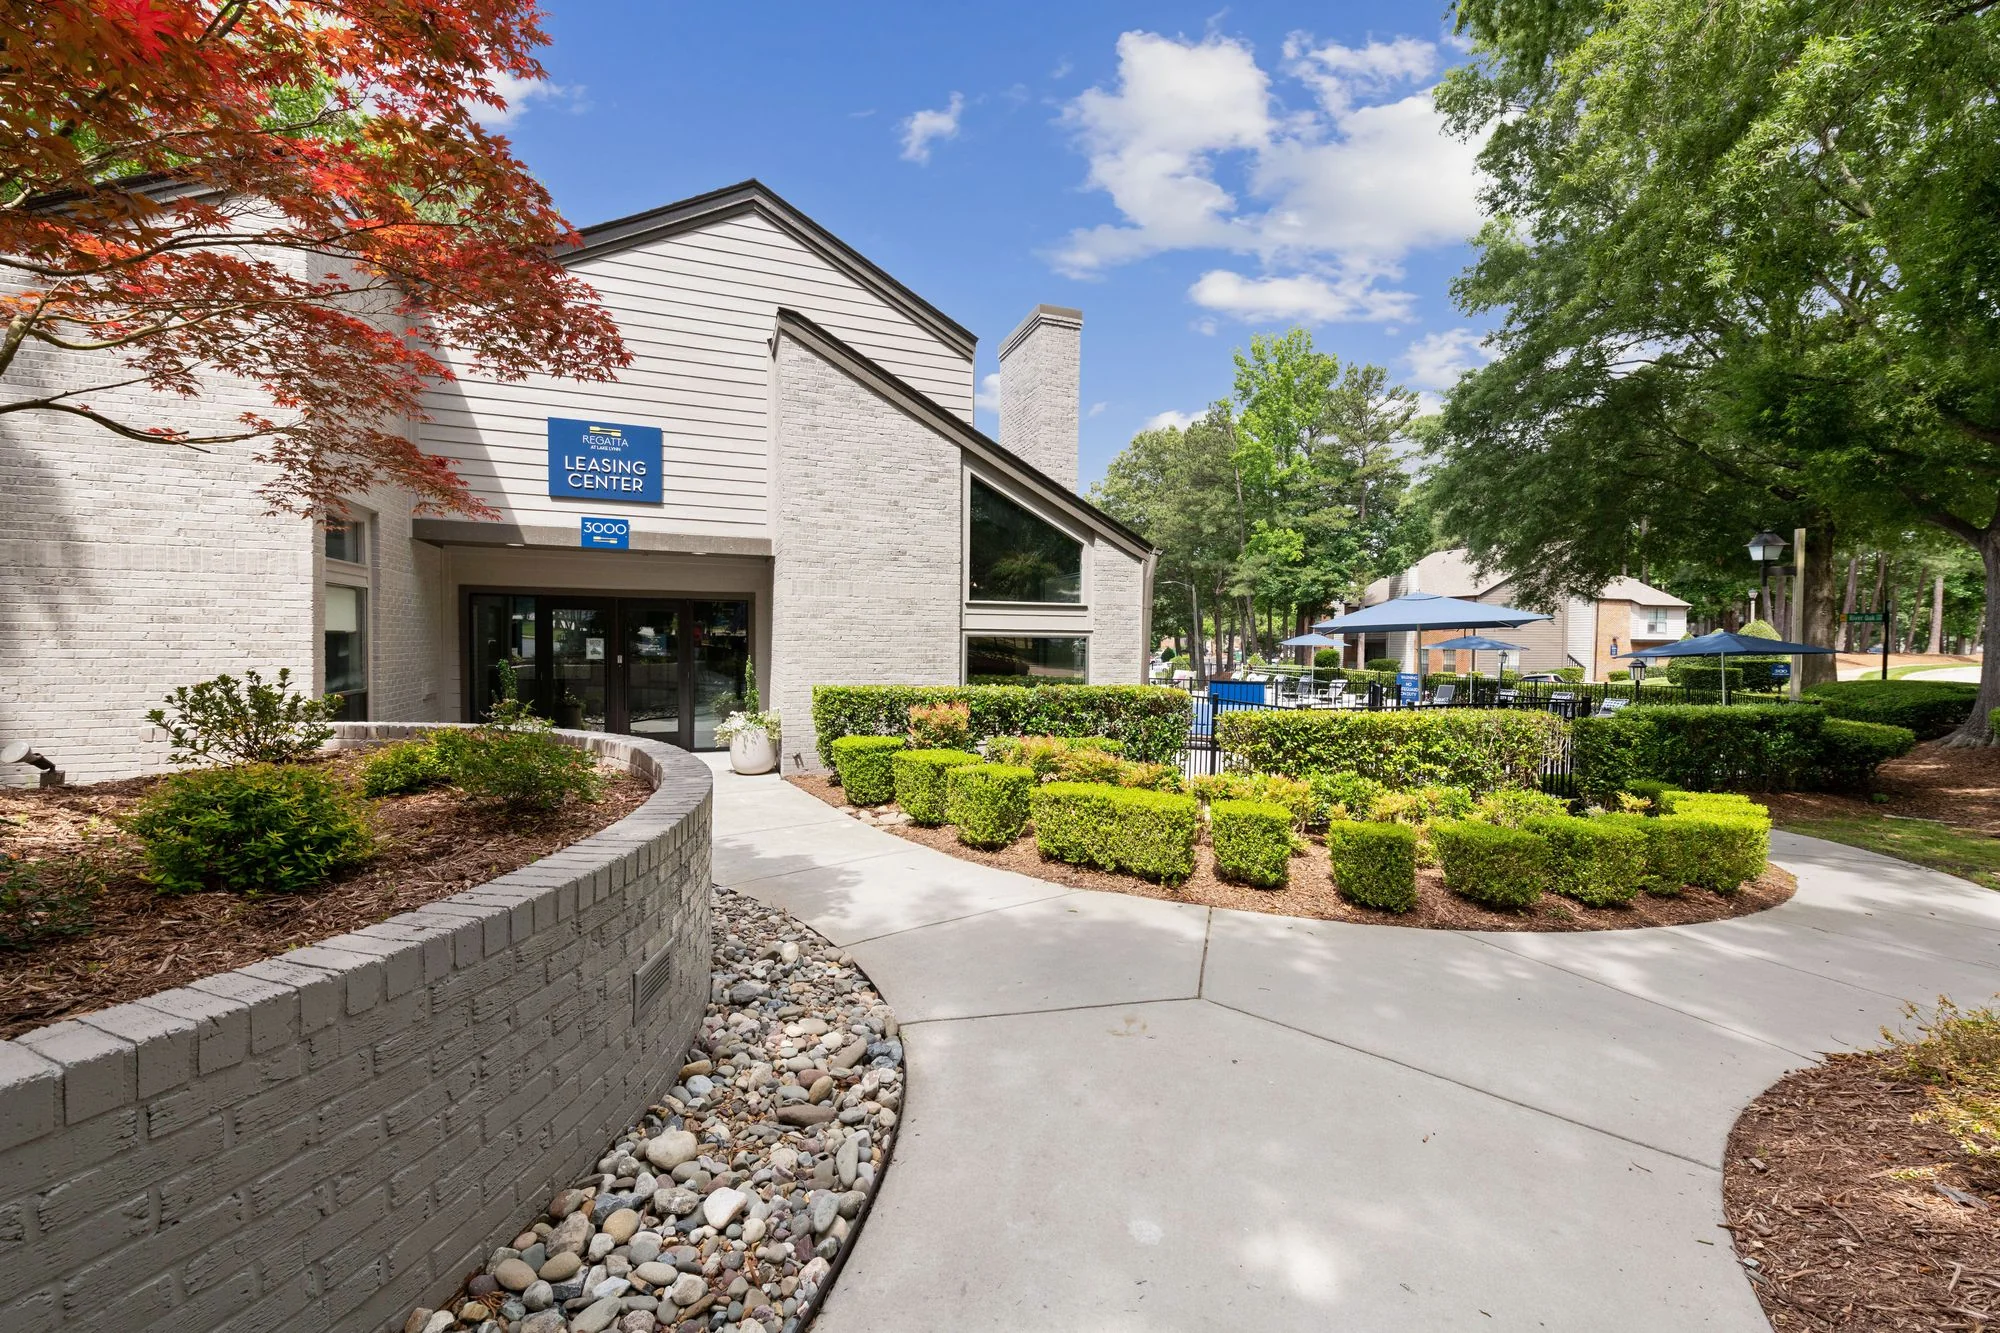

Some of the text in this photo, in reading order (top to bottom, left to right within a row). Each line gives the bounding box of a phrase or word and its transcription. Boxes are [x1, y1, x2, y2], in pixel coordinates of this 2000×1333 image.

[582, 434, 629, 447] REGATTA
[564, 455, 647, 475] LEASING
[568, 473, 643, 492] CENTER
[583, 522, 627, 534] 3000
